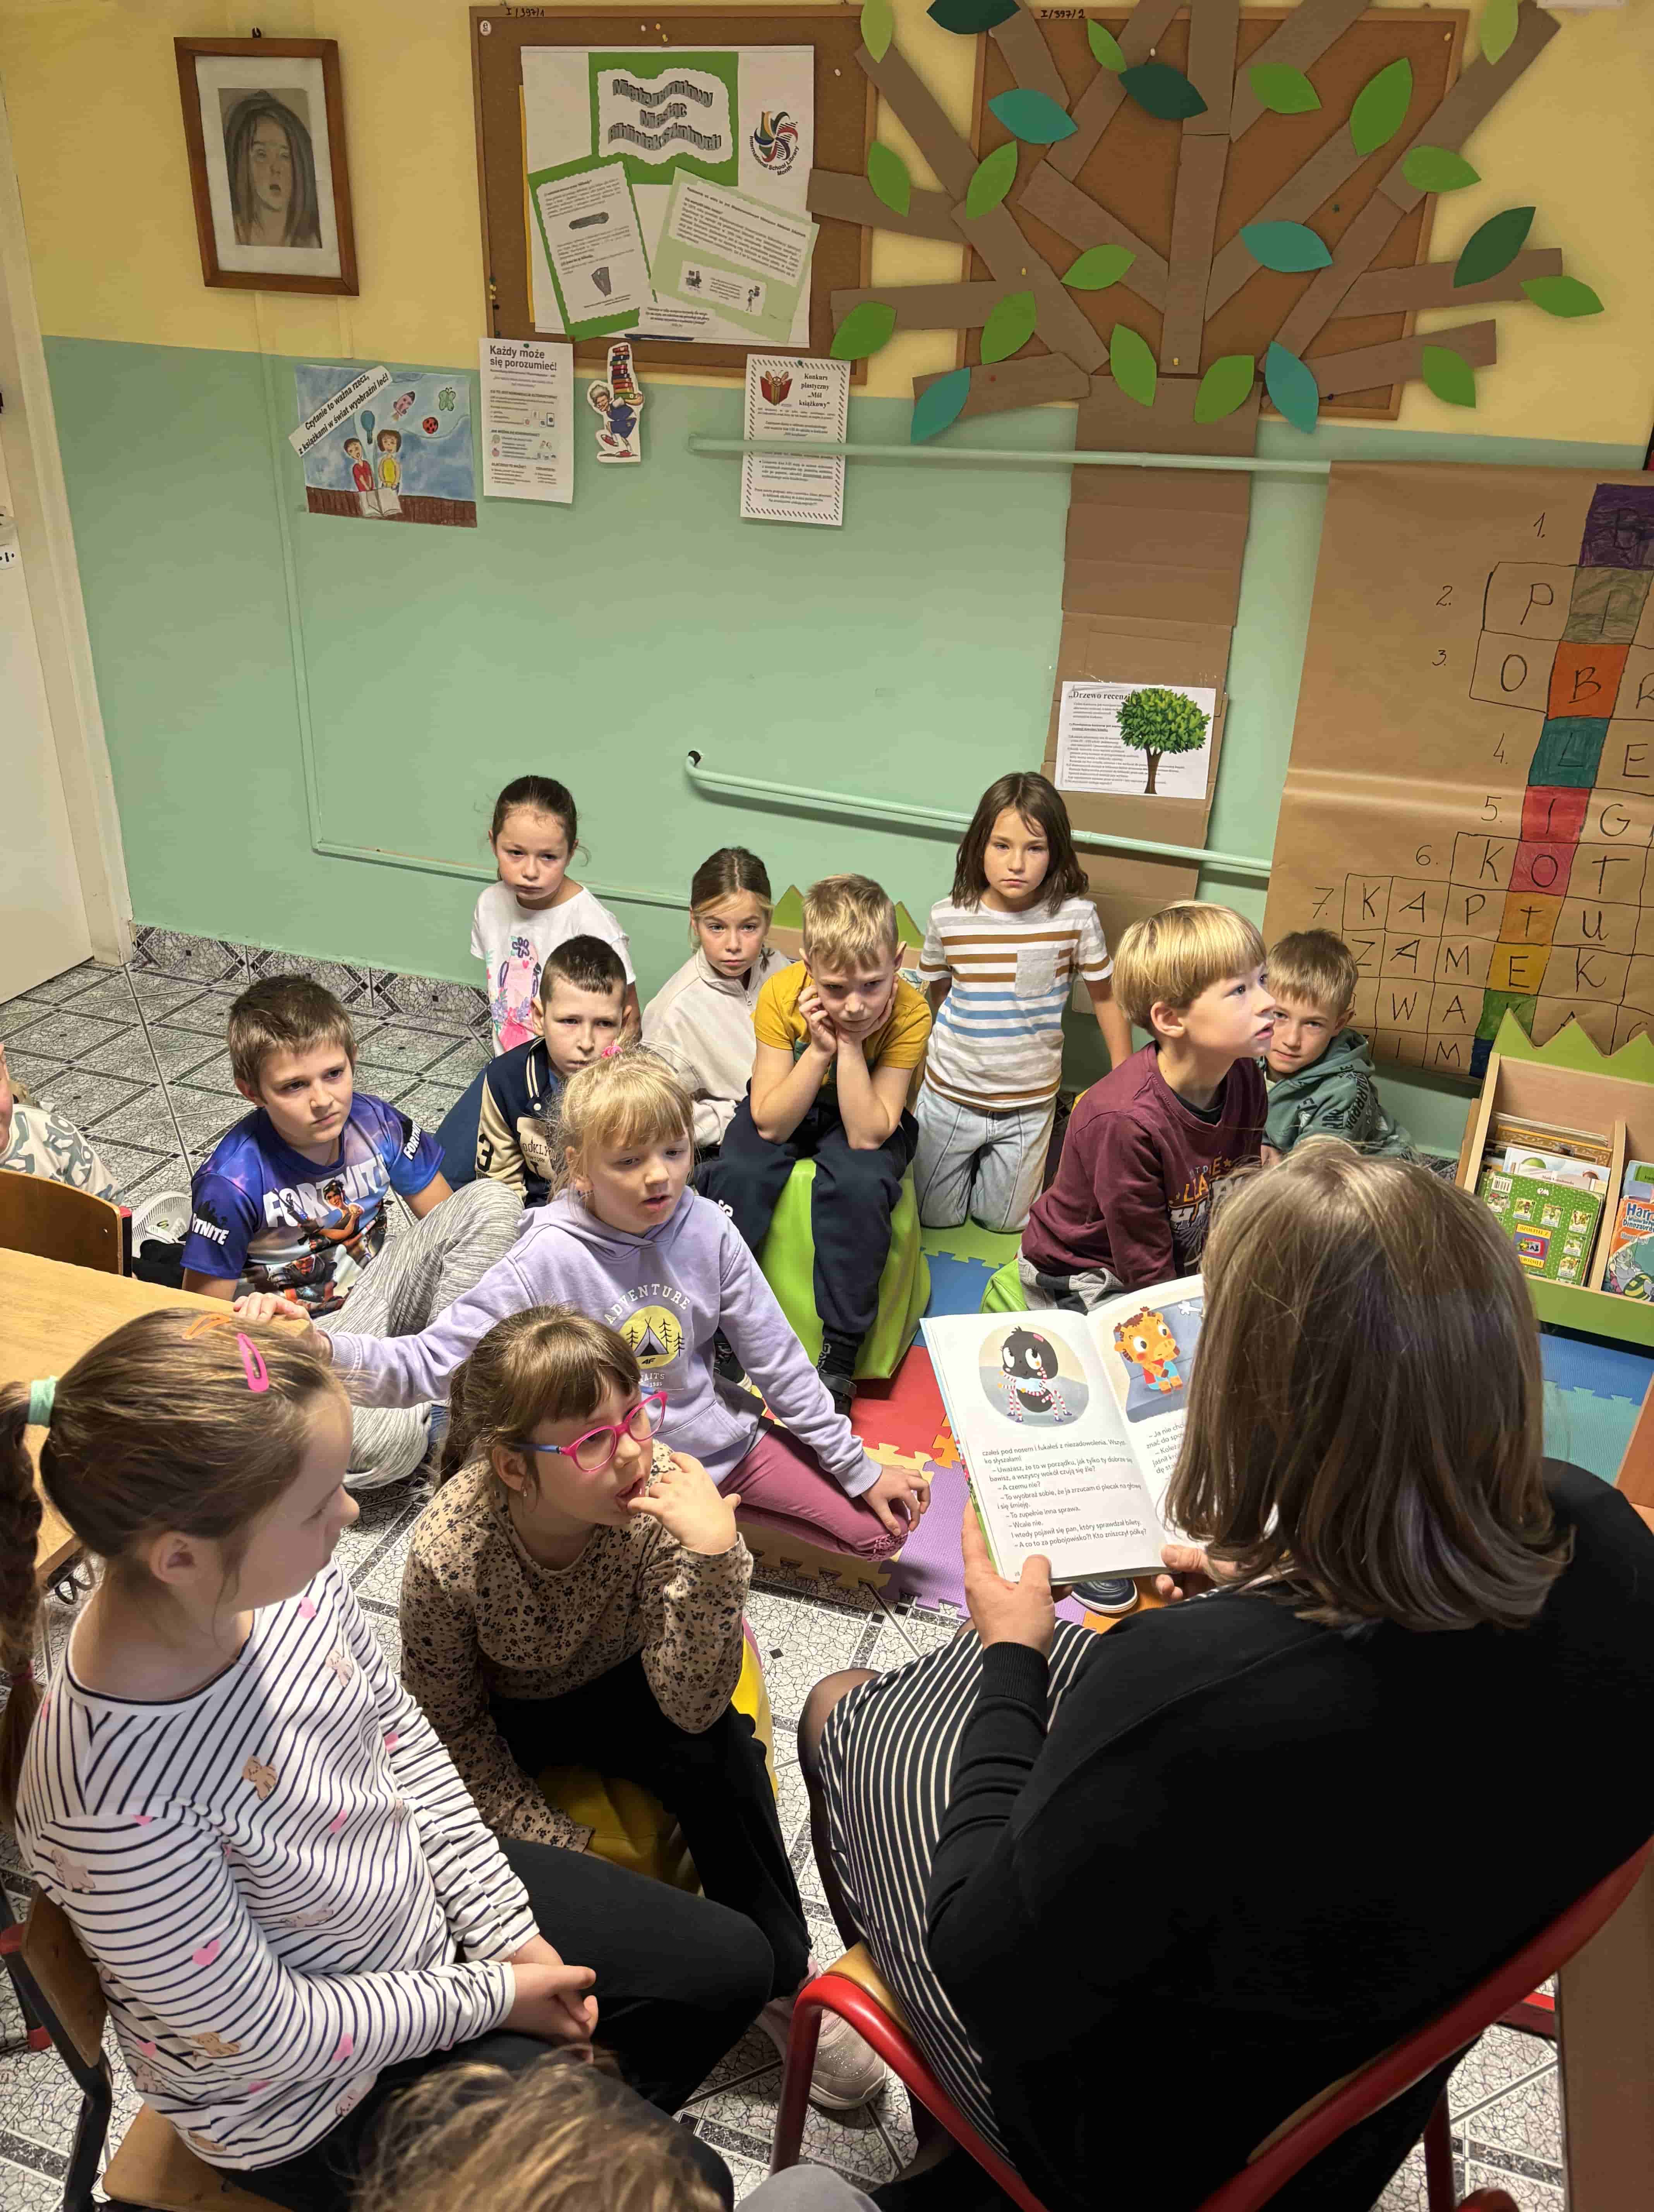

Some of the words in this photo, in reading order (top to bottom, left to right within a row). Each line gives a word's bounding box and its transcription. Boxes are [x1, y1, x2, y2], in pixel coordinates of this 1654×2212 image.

[749, 136, 769, 168] International
[786, 145, 800, 165] Library
[777, 165, 793, 176] Month
[490, 345, 517, 359] Każdy
[520, 349, 545, 359] może
[490, 357, 503, 368] się
[505, 360, 557, 371] porozumieć!
[801, 382, 829, 391] plastyczny
[305, 409, 328, 430] Czytanie
[334, 387, 353, 405] ważna
[353, 374, 370, 391] rzecz,
[302, 424, 328, 453] książkami
[333, 407, 349, 424] świat
[348, 382, 377, 411] wyobraźni
[377, 373, 389, 388] leć!
[477, 1133, 494, 1172] 3
[1627, 1202, 1654, 1221] Harr
[604, 1283, 691, 1324] ADVENTURE
[1001, 1447, 1013, 1456] pod
[993, 1456, 1022, 1465] słyszałam!
[1047, 1459, 1076, 1469] porządku,
[1086, 1457, 1100, 1465] tylko
[1040, 1468, 1059, 1476] wokół
[1060, 1467, 1075, 1475] czują
[1013, 1491, 1038, 1501] wyobraź
[1101, 1483, 1119, 1492] plecak
[1000, 1503, 1009, 1511] się
[1019, 1509, 1043, 1518] zupełnie
[1058, 1506, 1081, 1515] sprawa.
[1014, 1530, 1033, 1539] wtedy
[1034, 1528, 1055, 1538] pojawił
[1096, 1519, 1124, 1530] sprawdzał
[1124, 1518, 1141, 1527] bilety.
[1050, 1533, 1092, 1546] pobojowisko?!
[1105, 1530, 1128, 1538] zniszczył
[1129, 1528, 1147, 1537] półkę?
